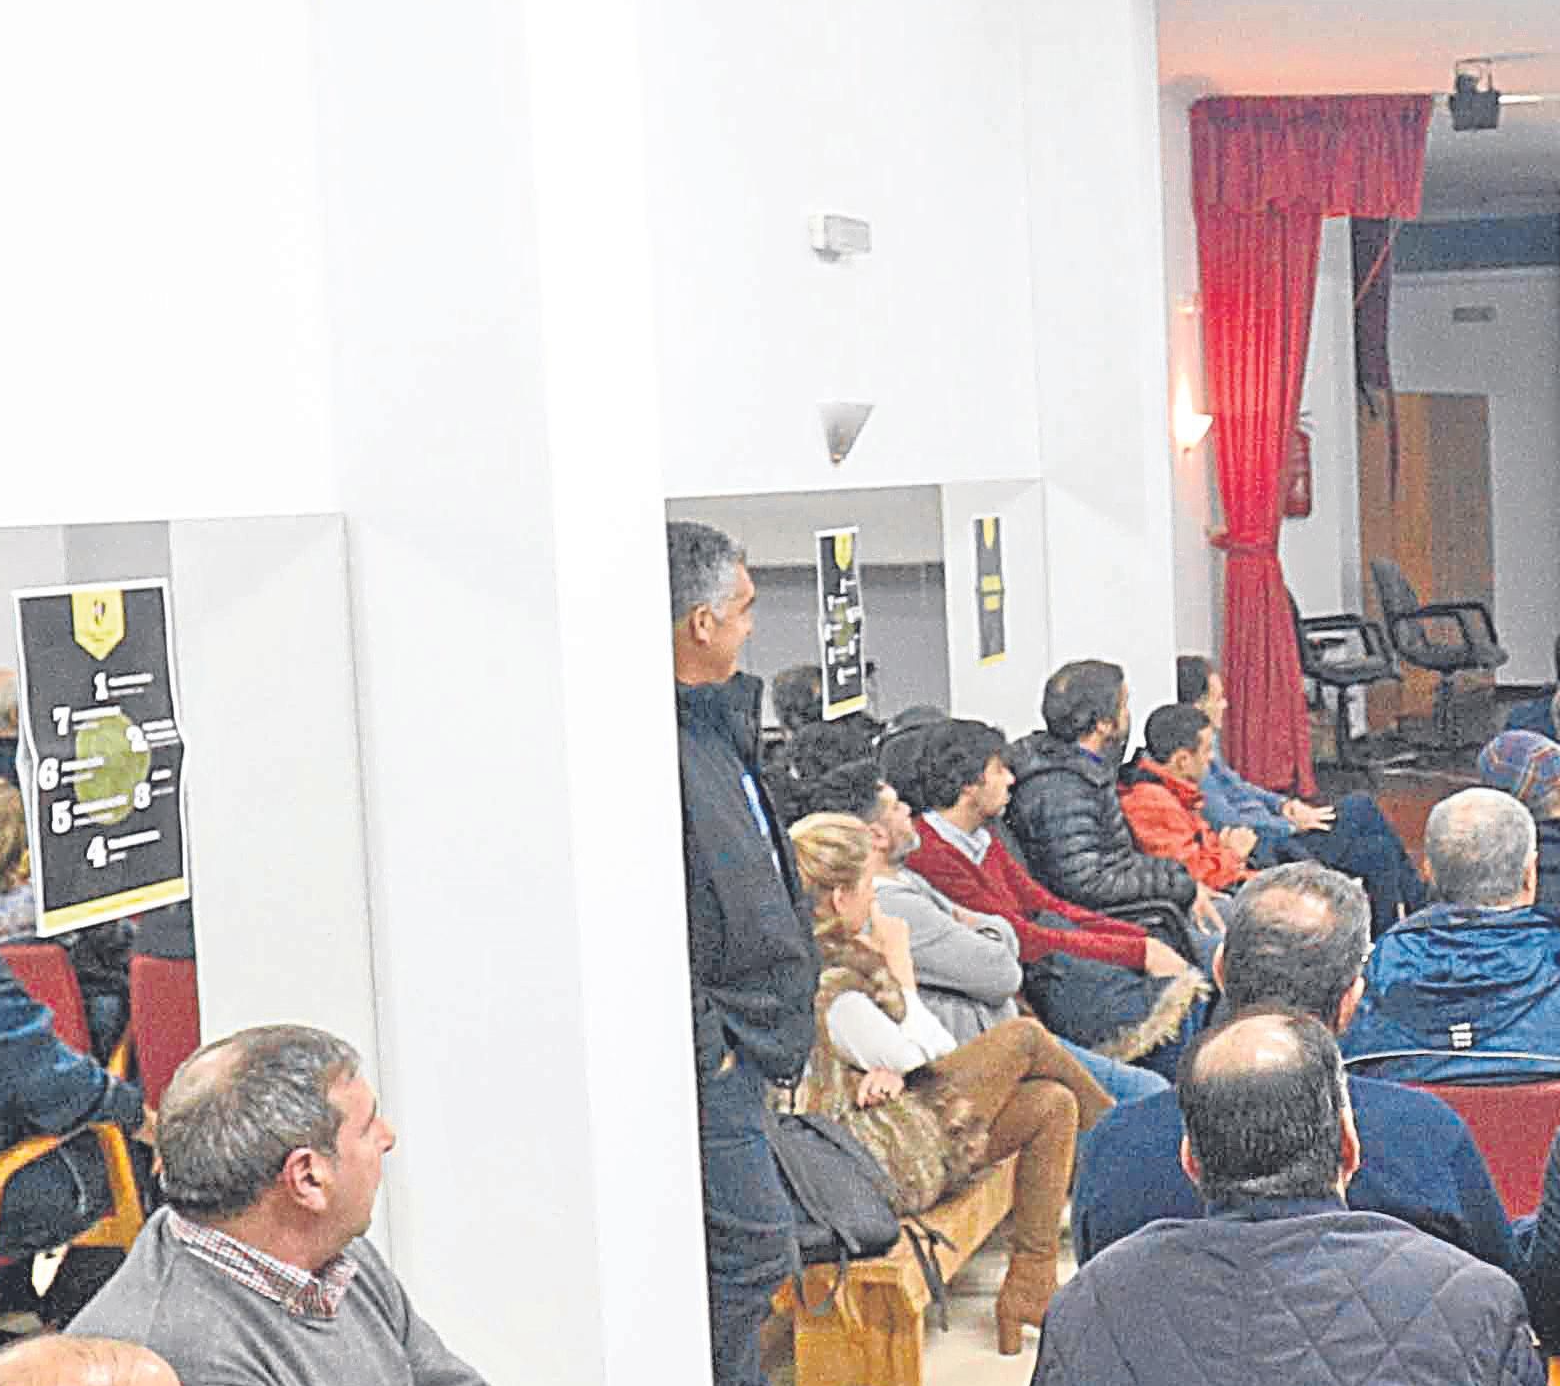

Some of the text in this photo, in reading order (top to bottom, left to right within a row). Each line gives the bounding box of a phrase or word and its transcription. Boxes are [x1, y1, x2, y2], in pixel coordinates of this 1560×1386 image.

[94, 672, 109, 701] 1
[53, 707, 71, 736] 7
[39, 757, 59, 790] 6
[52, 800, 72, 833] 5
[87, 836, 107, 868] 4
